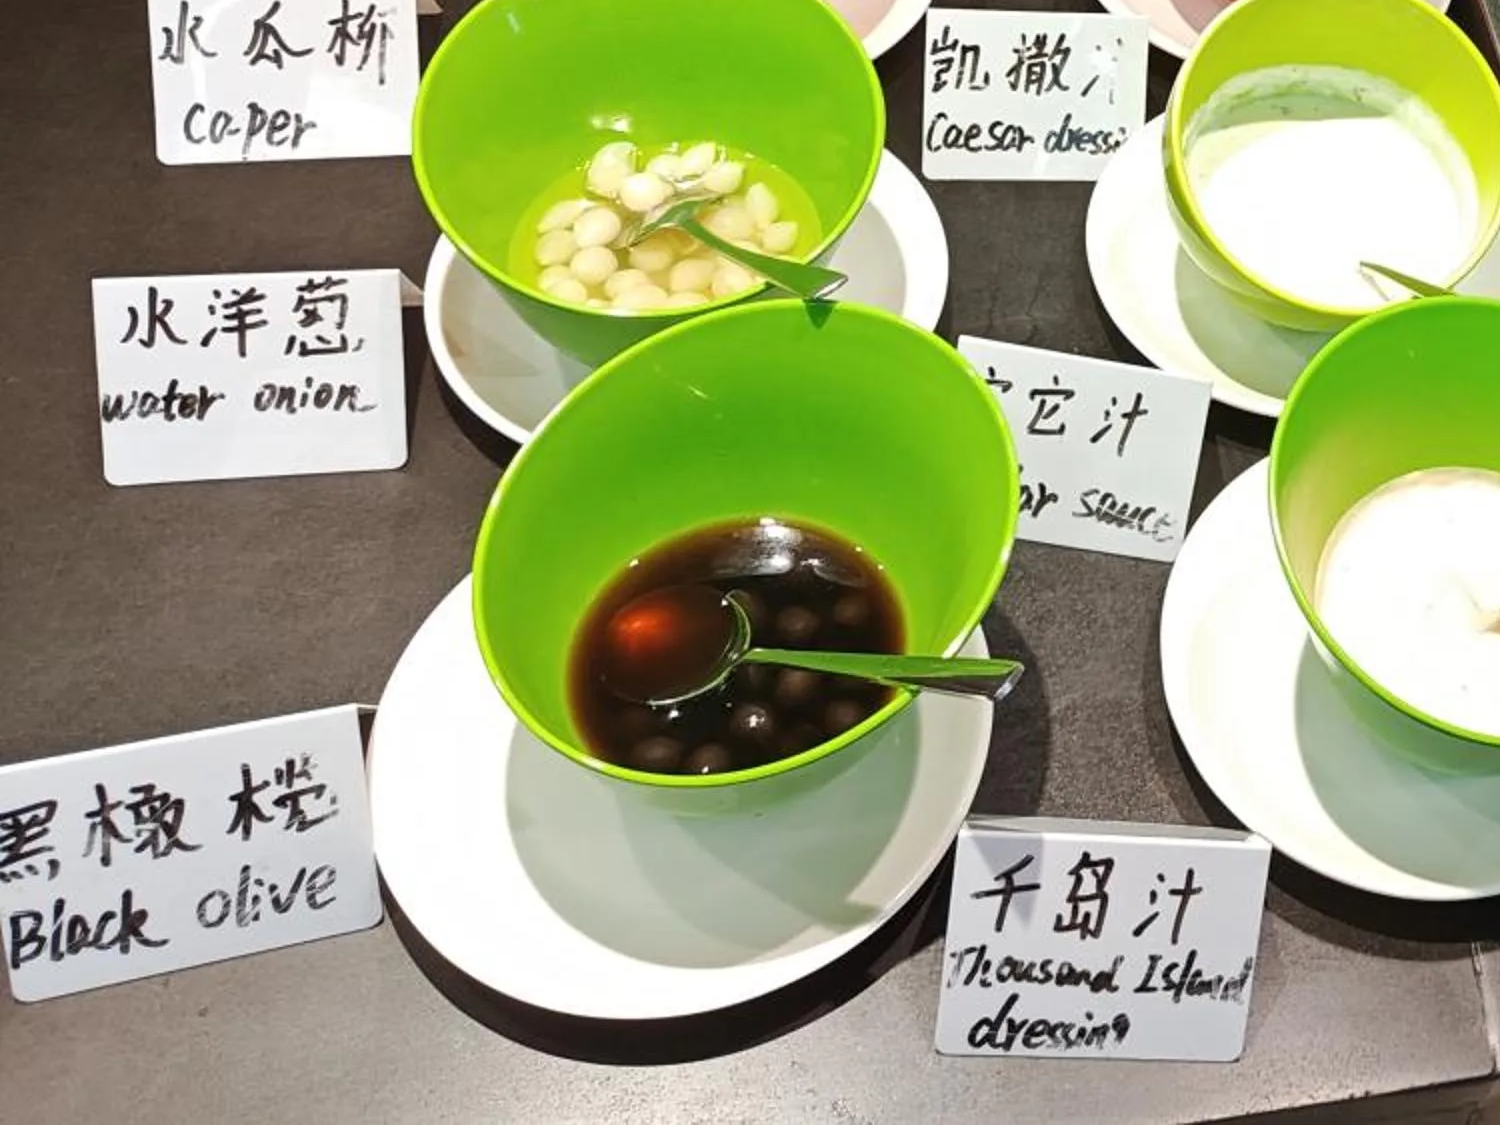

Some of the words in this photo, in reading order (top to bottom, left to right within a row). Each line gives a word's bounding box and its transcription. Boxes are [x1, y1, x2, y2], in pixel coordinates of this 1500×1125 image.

[927, 112, 1035, 152] Caesar
[120, 276, 364, 357] 水洋葱
[101, 379, 225, 422] water
[253, 377, 377, 414] onion
[9, 889, 169, 969] Black
[196, 864, 337, 928] olive
[971, 851, 1202, 945] 千岛汁
[947, 945, 1124, 993] Thousand
